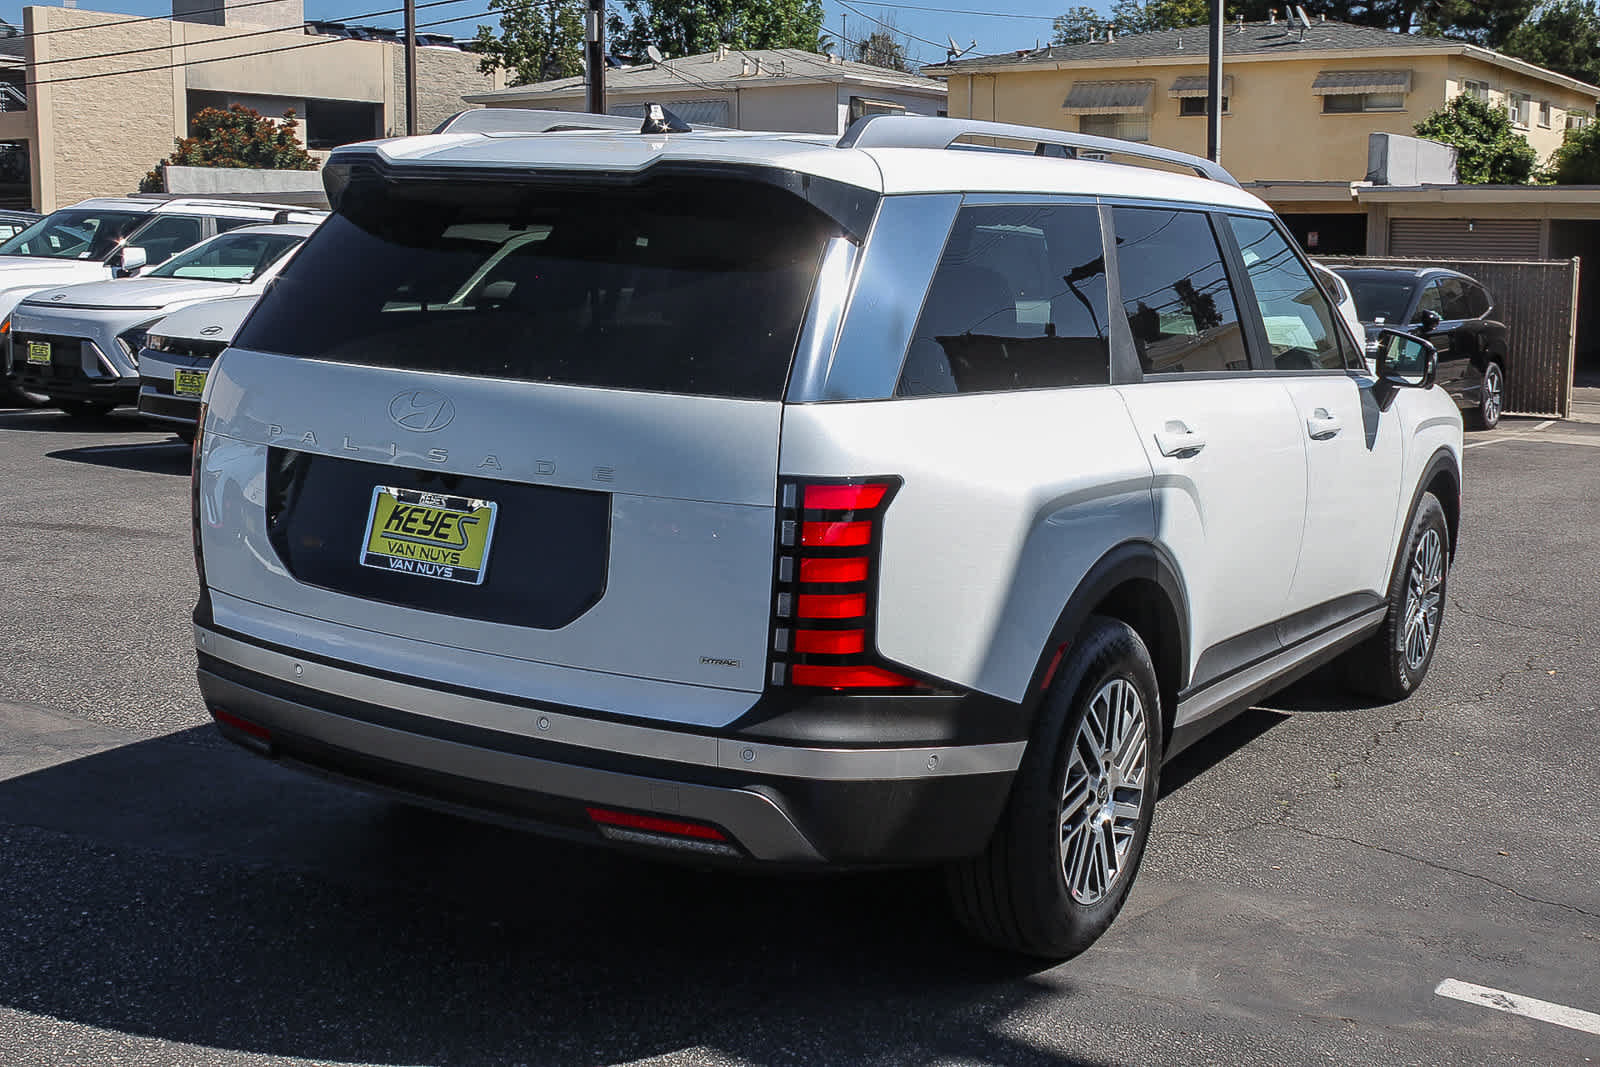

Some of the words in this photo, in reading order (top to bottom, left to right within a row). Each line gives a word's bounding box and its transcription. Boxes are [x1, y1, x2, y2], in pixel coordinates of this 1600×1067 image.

[268, 424, 616, 482] PALISADE
[420, 493, 448, 507] KEYES
[383, 505, 481, 551] KEYES
[388, 541, 416, 557] VAN
[419, 548, 461, 565] NUYS
[389, 558, 413, 571] VAN
[416, 563, 454, 578] NUYS
